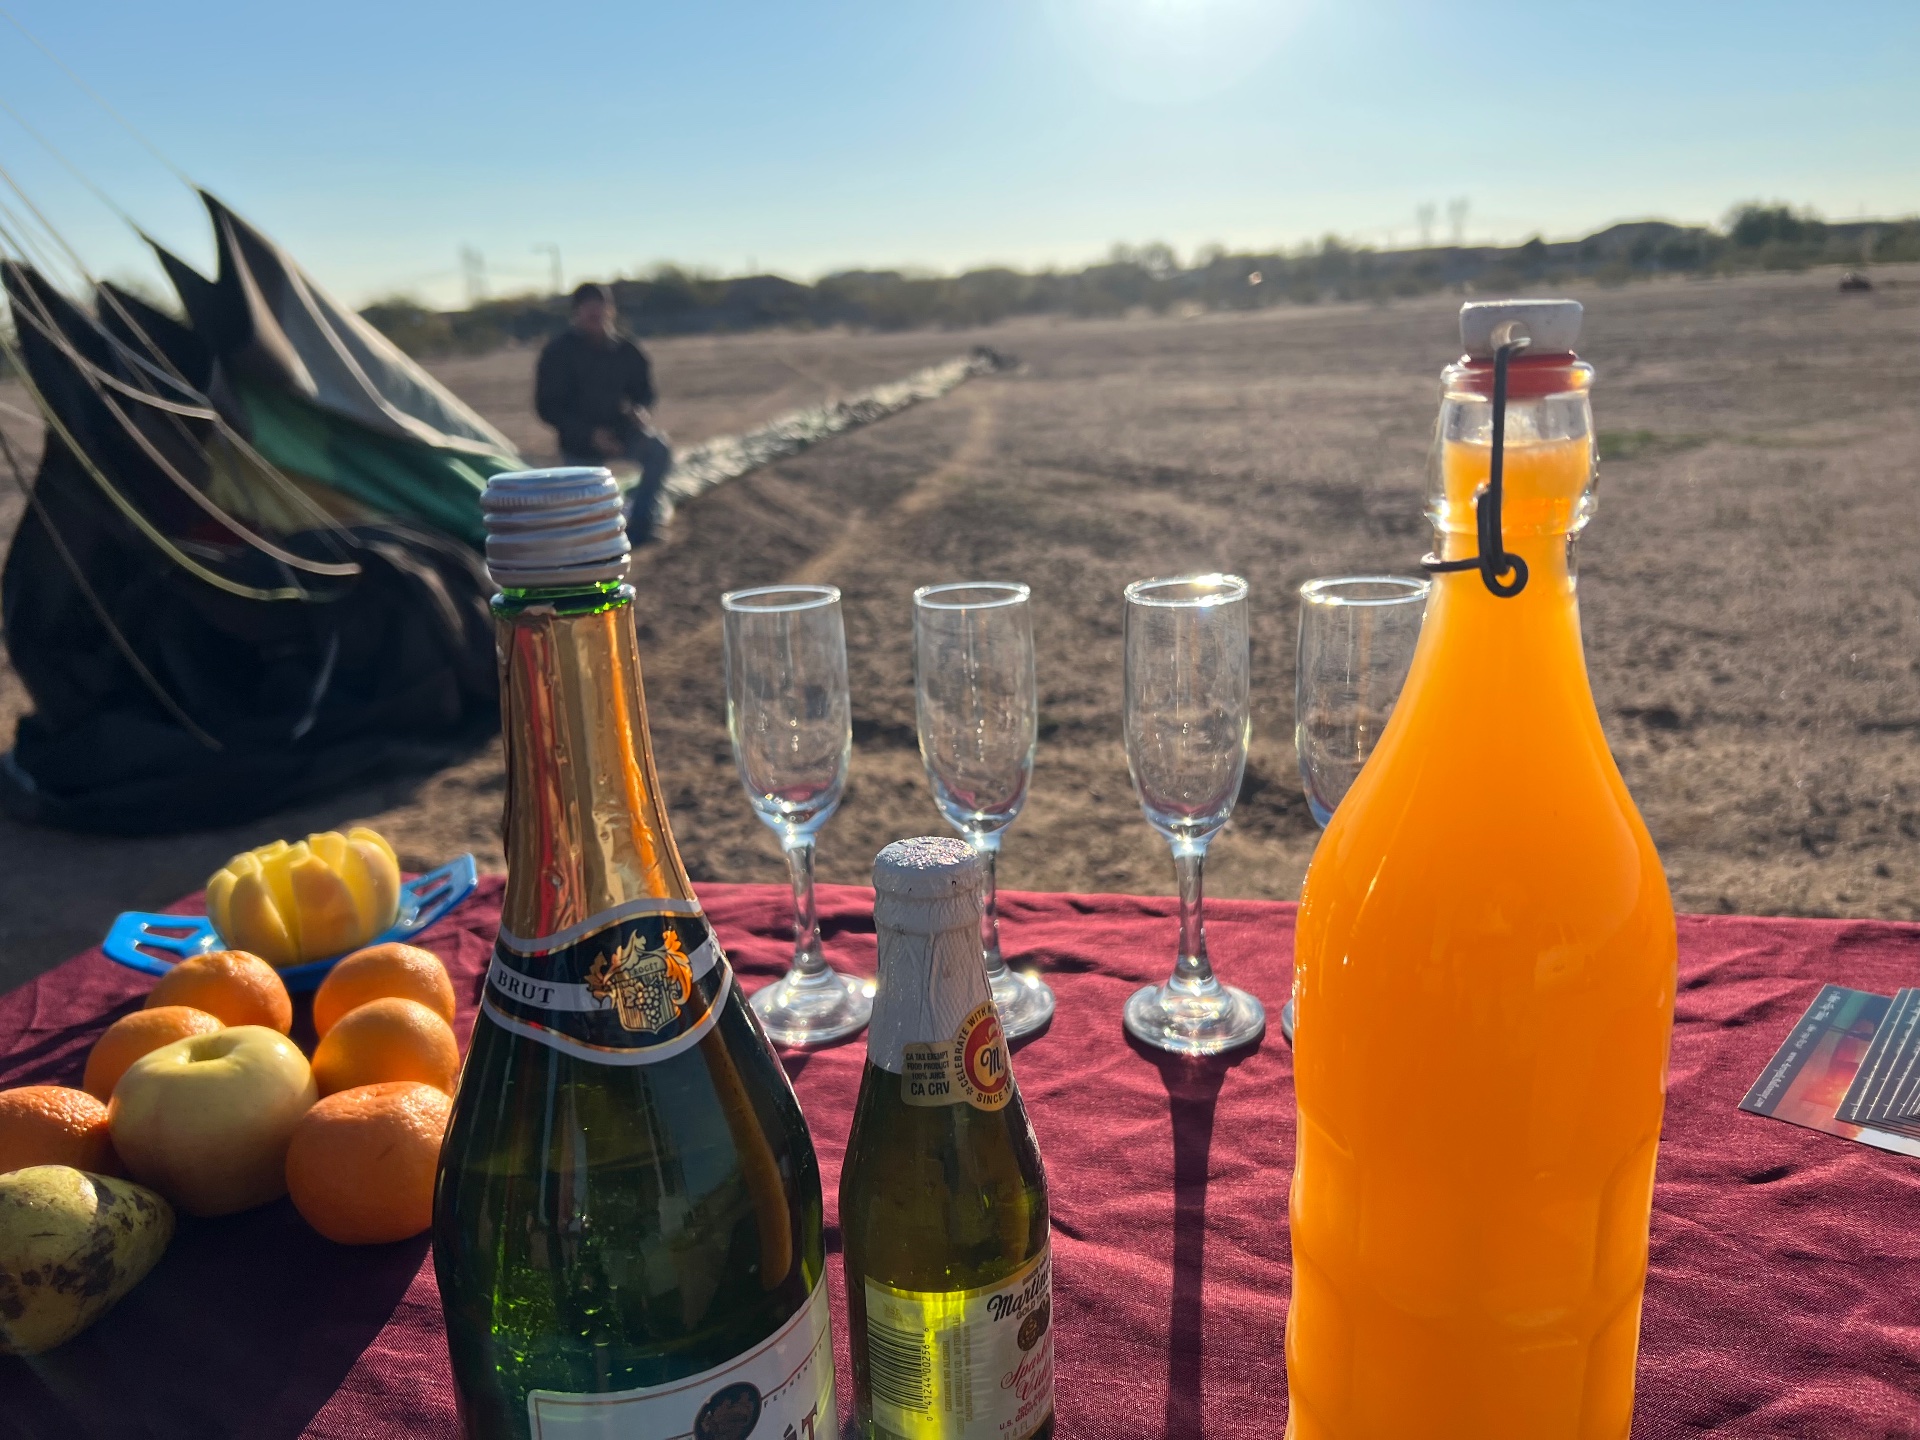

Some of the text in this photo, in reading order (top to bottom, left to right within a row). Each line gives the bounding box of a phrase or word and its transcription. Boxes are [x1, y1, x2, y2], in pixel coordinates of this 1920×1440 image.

[498, 968, 555, 1004] BRUT
[954, 1007, 987, 1088] CELEBRATE WITH
[905, 1051, 949, 1061] CA TAX EXEMPT
[907, 1060, 949, 1070] FOOD PRODUCT
[929, 1071, 946, 1080] JUICE
[910, 1081, 950, 1096] CA CRV
[976, 1092, 1003, 1104] SINCE
[921, 1344, 931, 1373] 00256
[922, 1377, 933, 1406] 41244
[943, 1380, 952, 1412] CONTAINS
[999, 1419, 1013, 1430] U.S.
